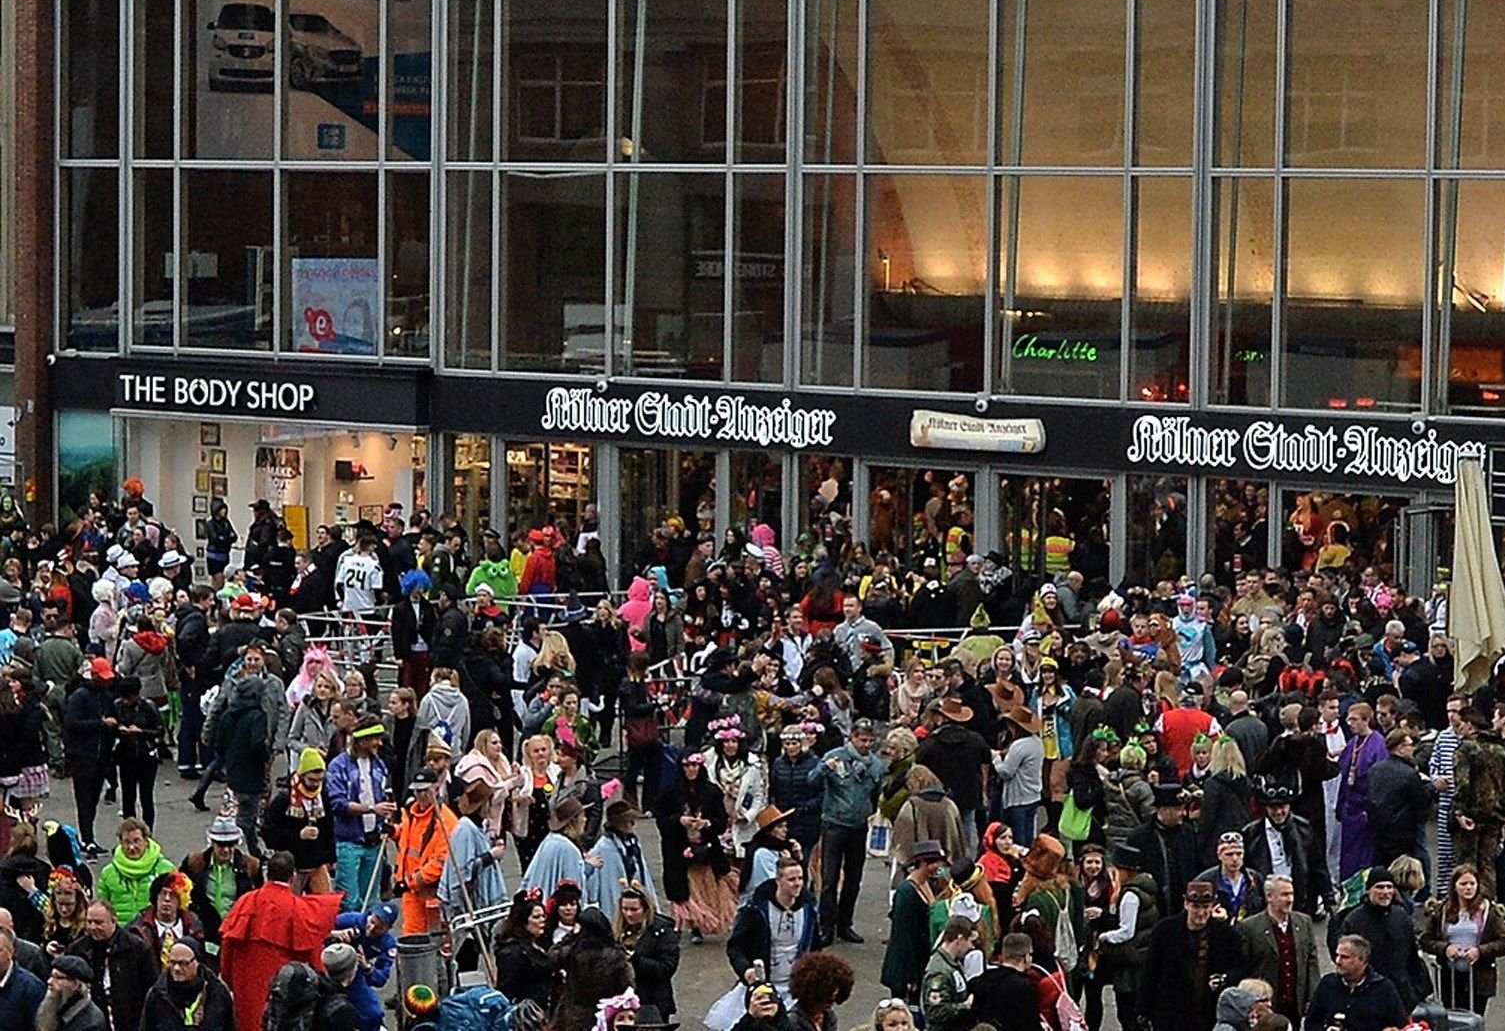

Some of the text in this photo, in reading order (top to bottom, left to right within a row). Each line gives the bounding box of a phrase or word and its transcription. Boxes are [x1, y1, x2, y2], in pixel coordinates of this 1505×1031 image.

[119, 374, 314, 412] THE BODY SHOP
[541, 386, 633, 433] Kölner
[1127, 415, 1239, 463] Kölner
[346, 568, 367, 591] 24
